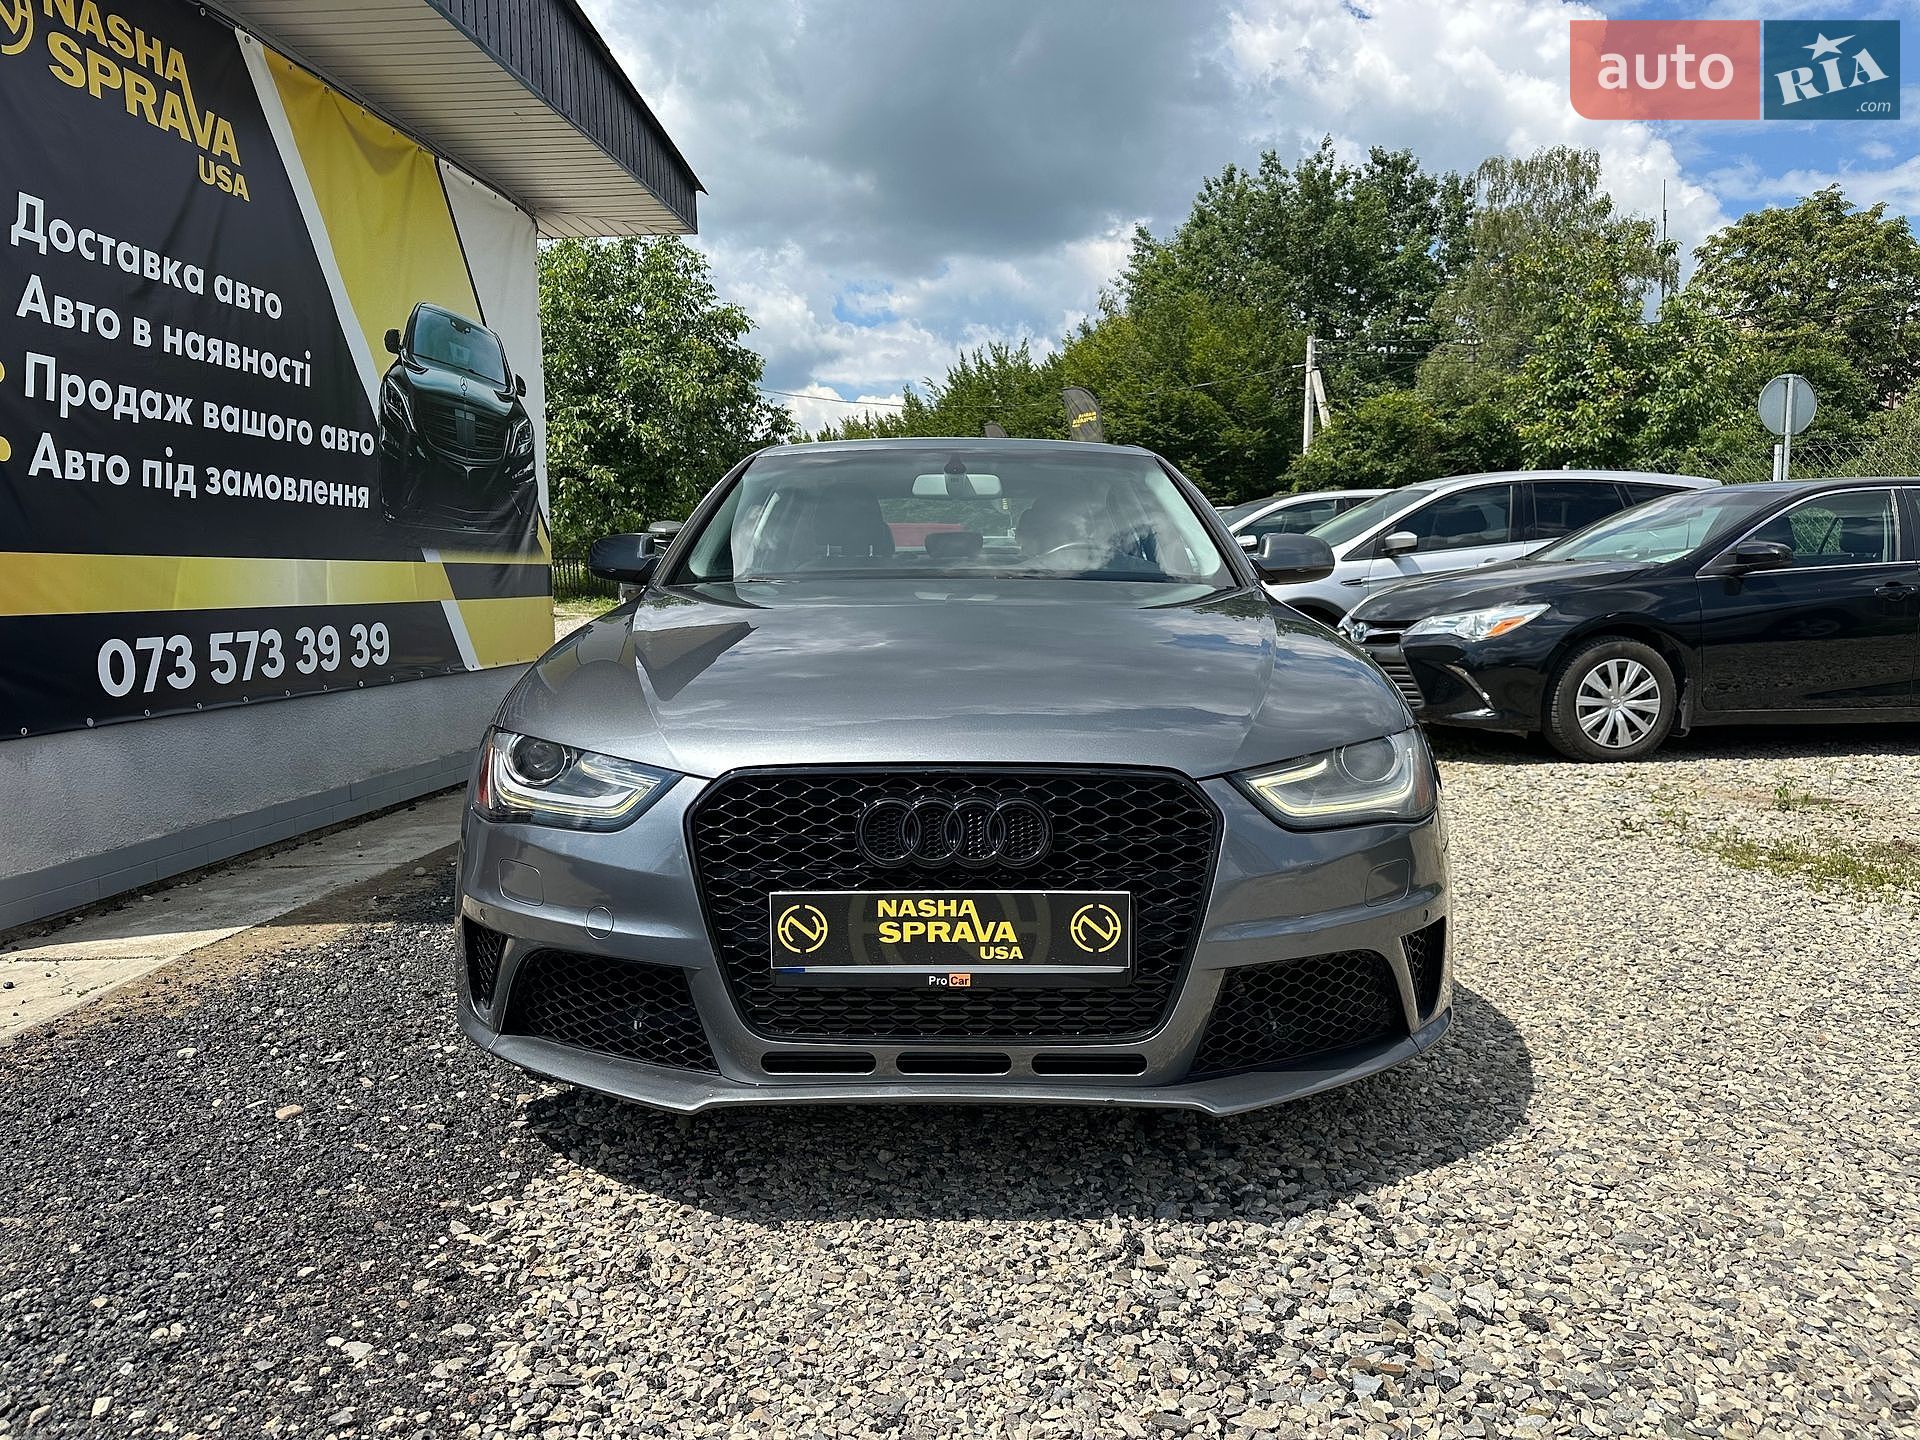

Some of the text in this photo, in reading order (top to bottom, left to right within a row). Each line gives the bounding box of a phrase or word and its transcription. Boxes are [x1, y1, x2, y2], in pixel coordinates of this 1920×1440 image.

[47, 31, 241, 166] SPRAVA
[198, 154, 250, 202] USA
[10, 191, 283, 320] Доставка авто
[16, 273, 312, 387] Авто в наявності
[25, 351, 375, 456] Продаж вашого авто
[28, 432, 370, 509] Авто під замовлення
[97, 622, 390, 697] 073 573 39 39
[877, 899, 975, 918] NASHA
[878, 921, 1018, 944] SPRAVA
[979, 946, 1024, 960] USA
